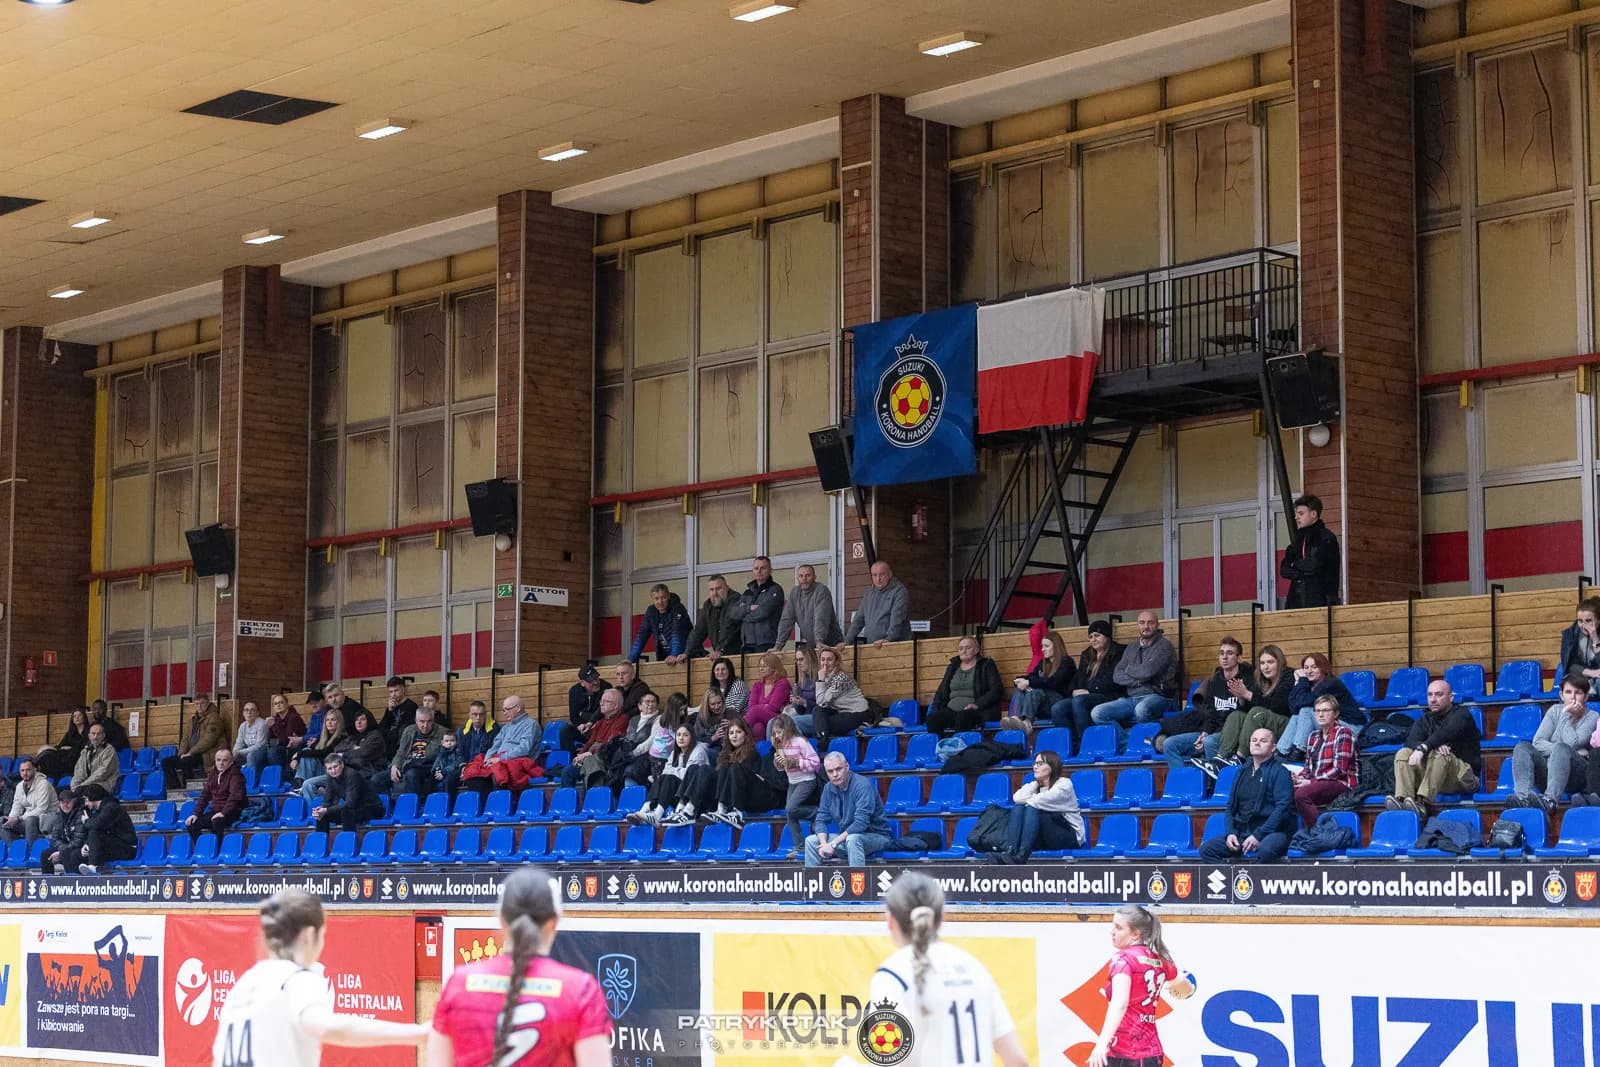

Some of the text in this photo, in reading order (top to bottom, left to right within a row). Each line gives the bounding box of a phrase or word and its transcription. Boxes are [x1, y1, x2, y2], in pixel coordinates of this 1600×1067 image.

[897, 361, 925, 376] SUZUKI
[880, 404, 940, 441] KORONA HANDBALL
[523, 592, 538, 603] A
[524, 586, 566, 596] SEKTOR
[240, 626, 252, 635] B
[50, 879, 160, 900] www.koronahandball.pl
[643, 871, 823, 899] www.koronahandball.pl
[934, 870, 1141, 901] ww.koronahandball.pl
[1176, 882, 1188, 896] CK
[1261, 871, 1534, 905] www.koronahandball.pl
[1577, 883, 1593, 897] CK
[213, 969, 236, 985] LIGA
[337, 973, 362, 989] LIGA
[37, 1000, 136, 1019] Zawsze jest pora na targi...
[337, 993, 403, 1011] CENTRALNA
[37, 1018, 85, 1033] i kibicowanie
[948, 999, 980, 1064] 11
[1201, 989, 1600, 1067] SUZU
[222, 1019, 254, 1067] 44
